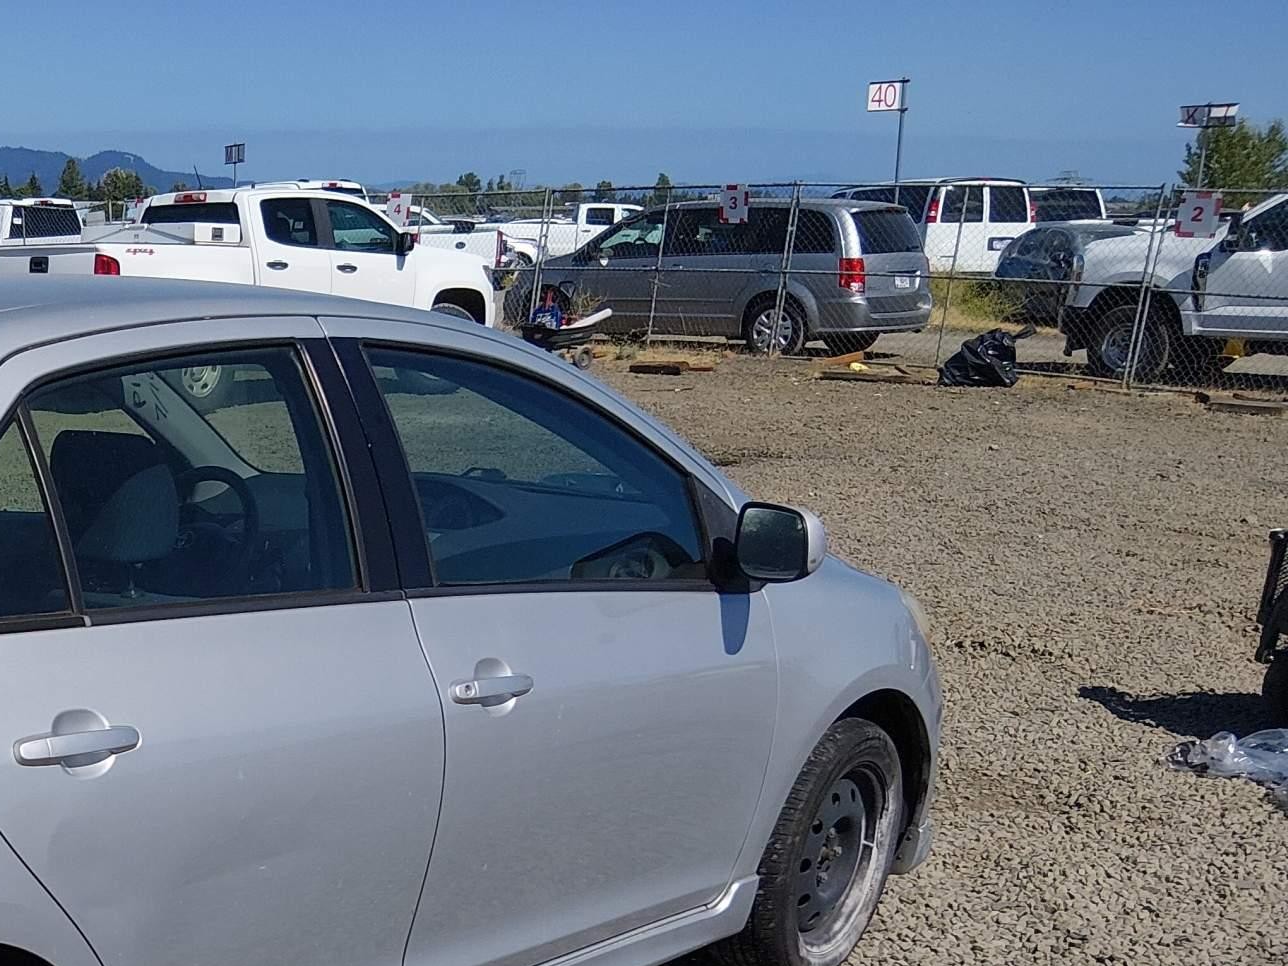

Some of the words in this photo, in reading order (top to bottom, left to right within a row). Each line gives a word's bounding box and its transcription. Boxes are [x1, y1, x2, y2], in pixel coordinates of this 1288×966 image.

[871, 84, 897, 108] 40
[1184, 107, 1199, 125] K
[393, 203, 402, 215] 4
[729, 196, 738, 210] 3
[1191, 206, 1204, 222] 2
